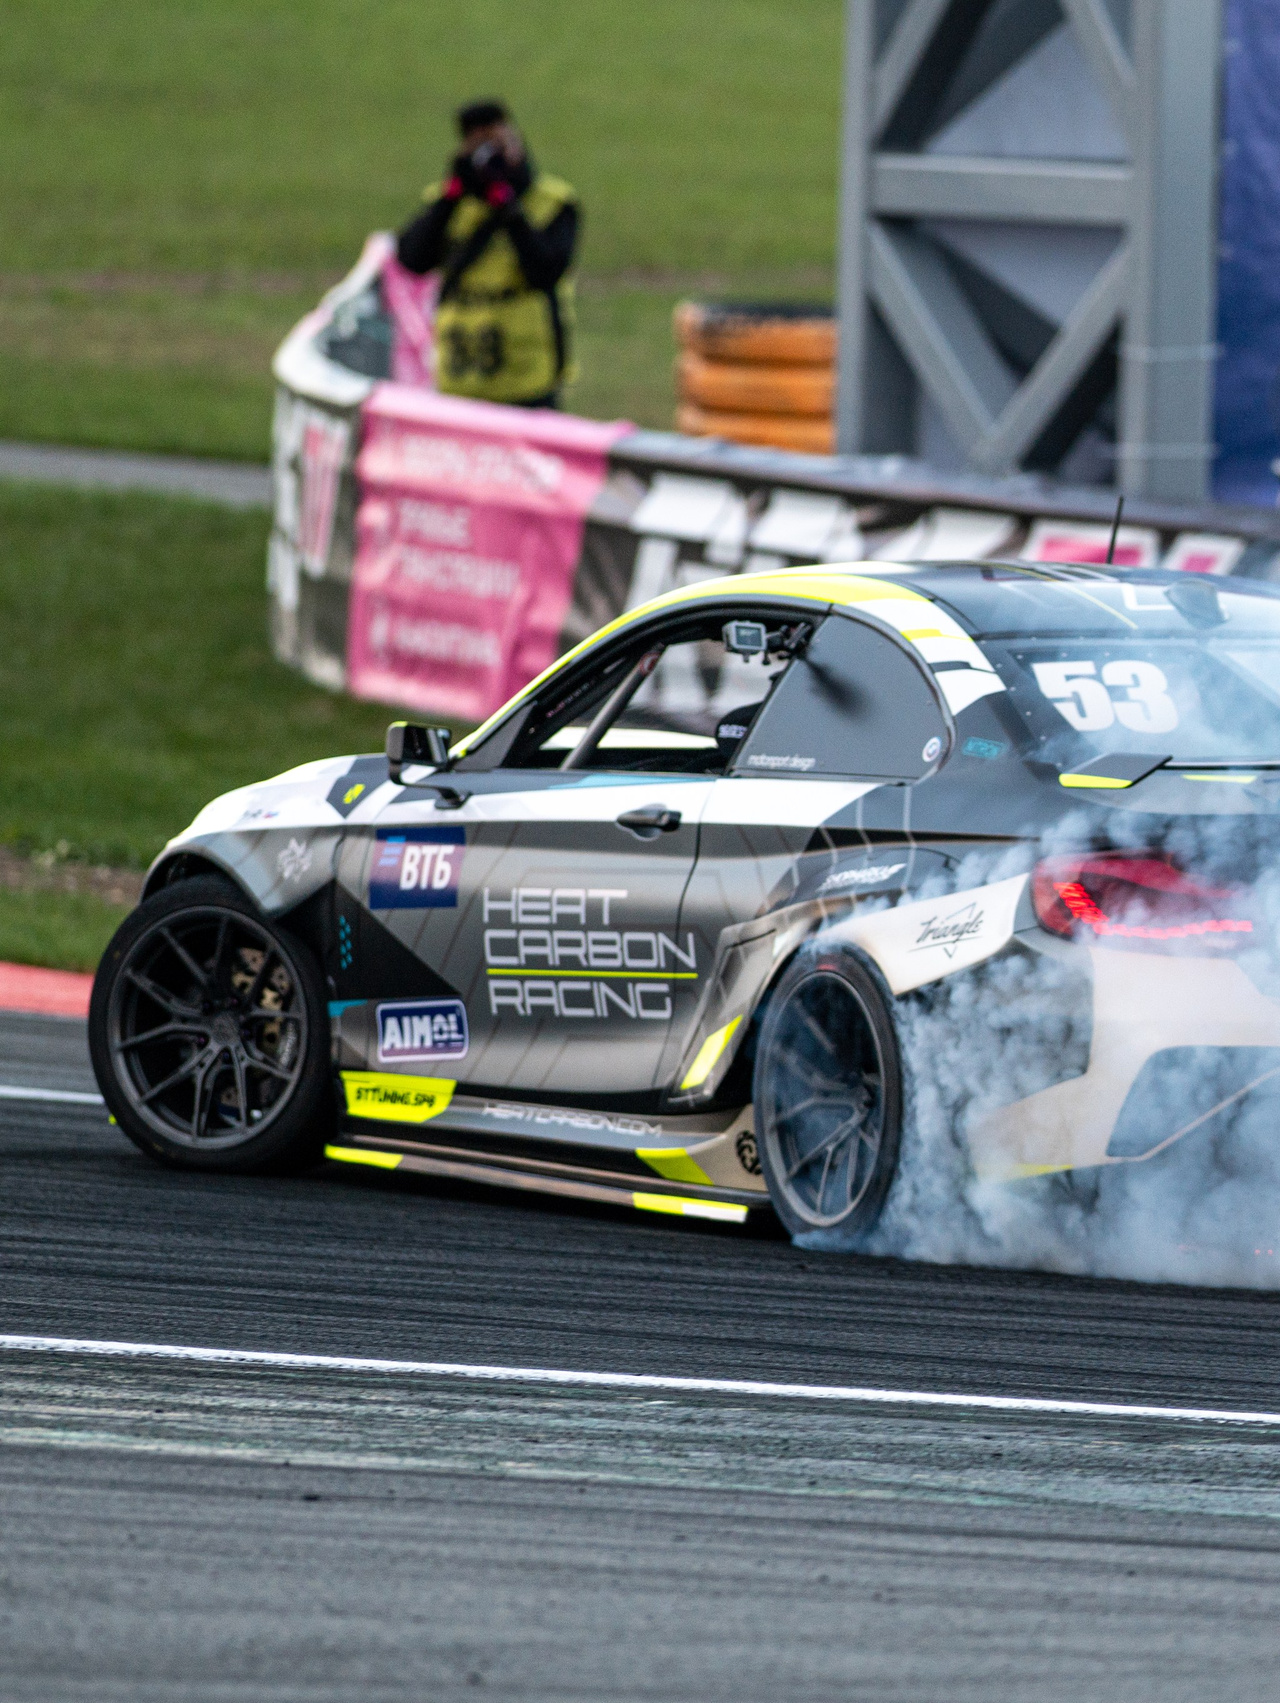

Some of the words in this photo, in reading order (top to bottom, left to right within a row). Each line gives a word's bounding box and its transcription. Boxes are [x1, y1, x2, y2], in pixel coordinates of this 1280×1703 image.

[1031, 660, 1179, 733] 53
[400, 844, 456, 890] ВТБ
[482, 887, 628, 926] HEAT
[915, 908, 984, 944] Triangle
[484, 929, 697, 969] CARBON
[488, 980, 672, 1019] RACING
[383, 1013, 464, 1050] AIMOL
